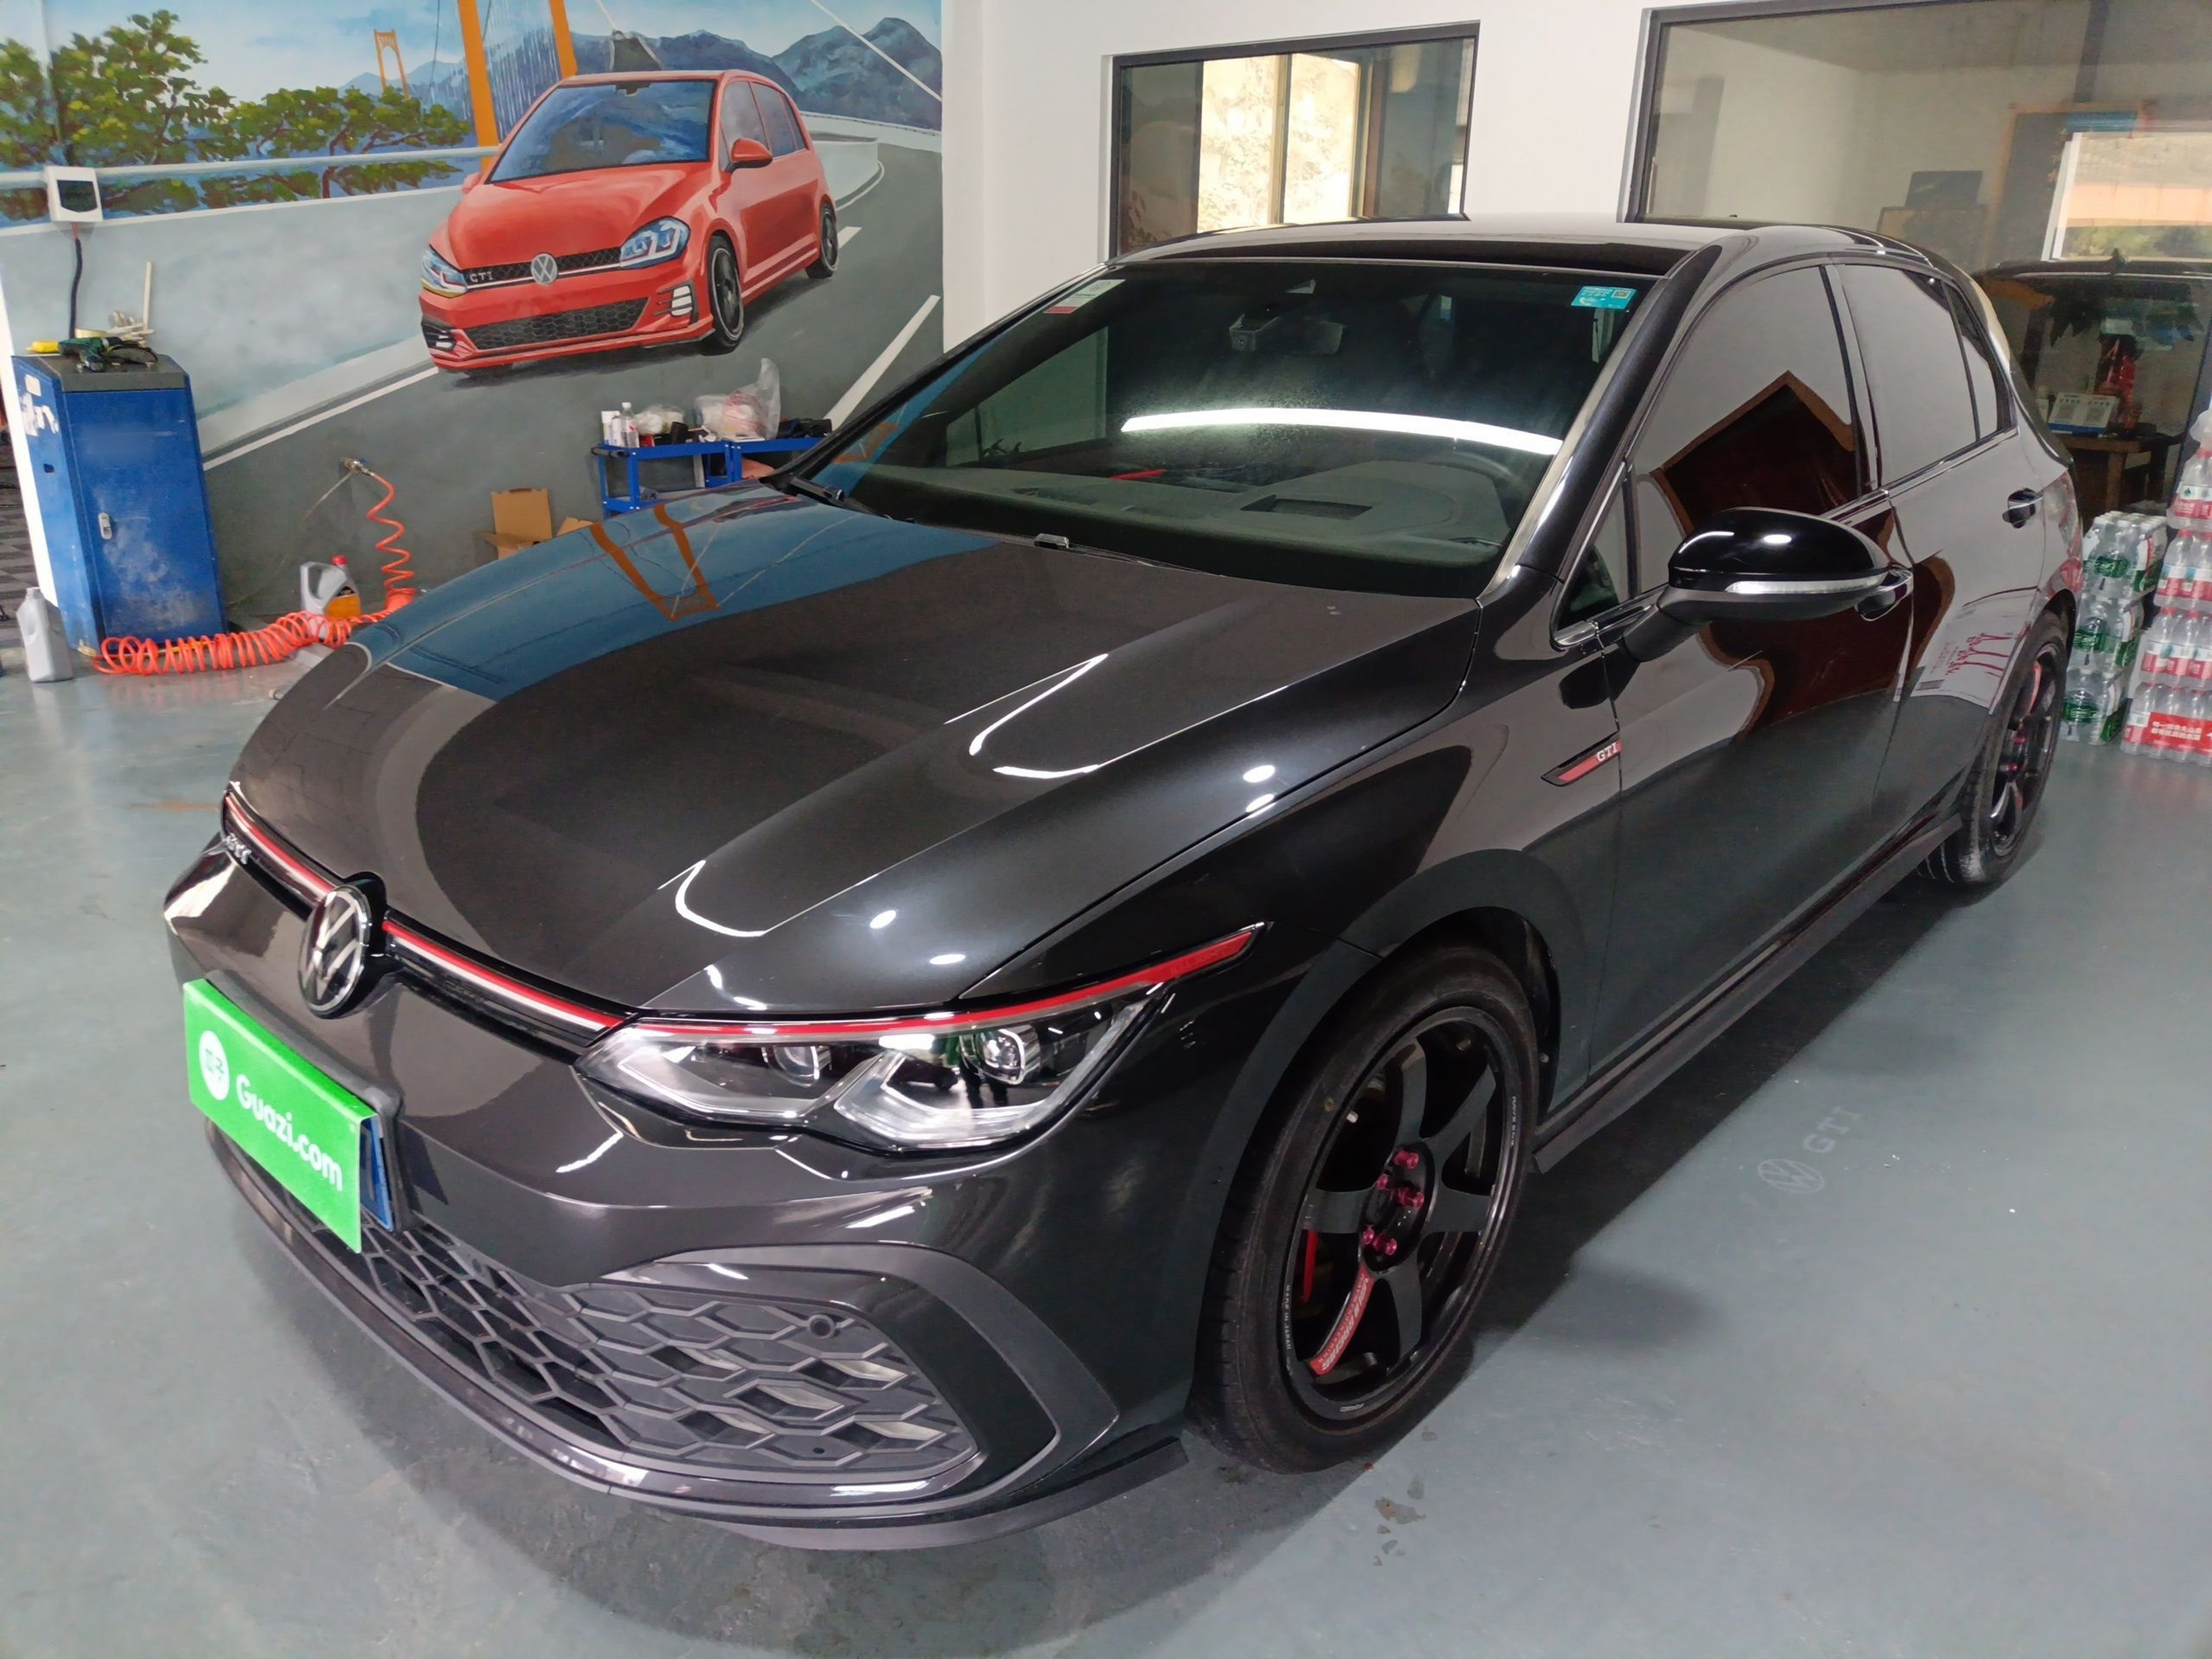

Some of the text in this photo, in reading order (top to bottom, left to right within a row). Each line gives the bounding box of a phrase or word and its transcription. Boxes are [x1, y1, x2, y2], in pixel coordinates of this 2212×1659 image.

[1596, 742, 1618, 762] GTI
[236, 1074, 343, 1192] Guazi.com
[1802, 1106, 1861, 1154] GTI
